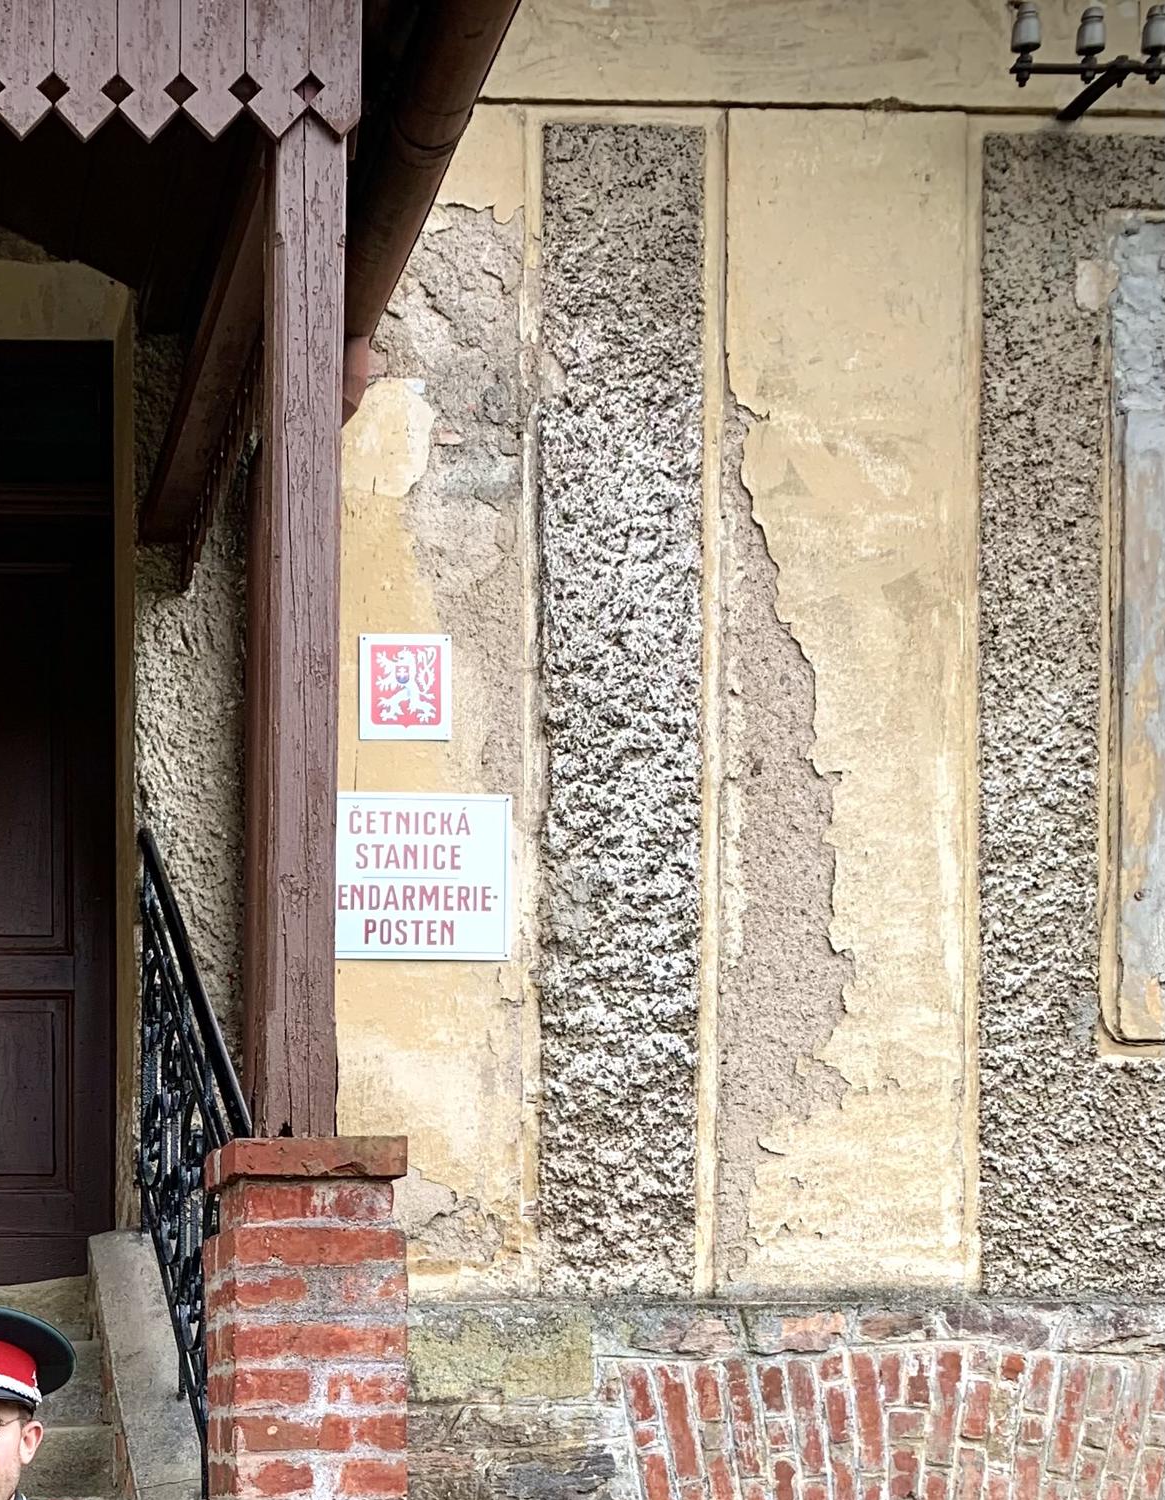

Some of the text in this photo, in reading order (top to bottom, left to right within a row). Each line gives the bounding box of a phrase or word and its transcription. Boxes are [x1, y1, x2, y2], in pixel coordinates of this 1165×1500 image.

[348, 804, 471, 836] ČETNICKÁ
[355, 843, 462, 871] STANICE
[337, 884, 499, 912] ENDARMERIE-
[364, 918, 455, 946] POSTEN
